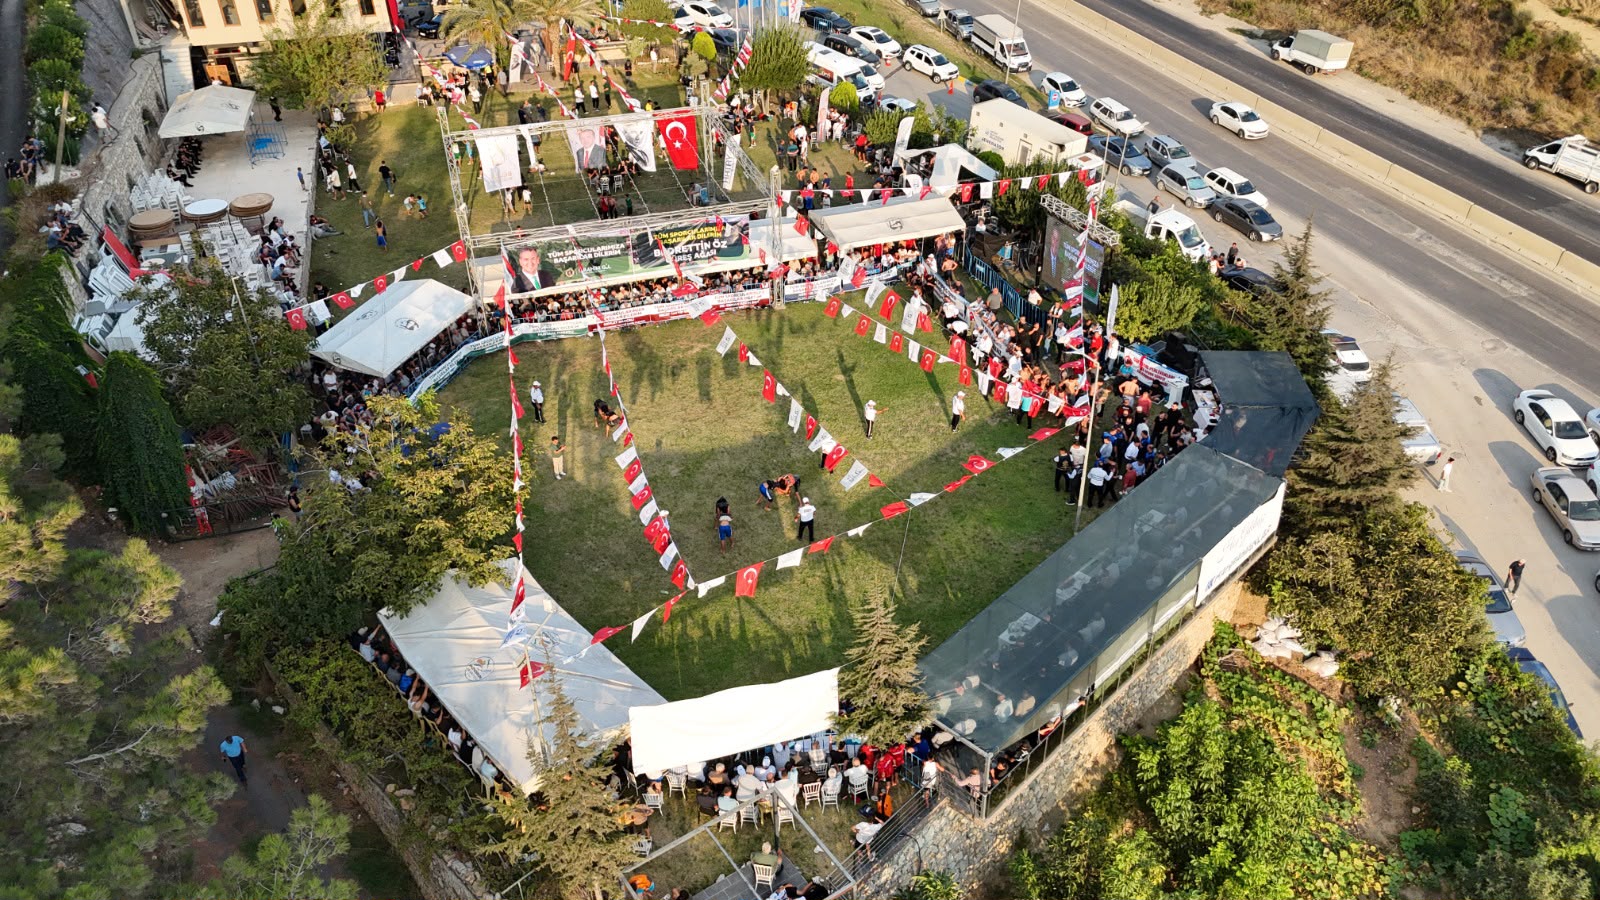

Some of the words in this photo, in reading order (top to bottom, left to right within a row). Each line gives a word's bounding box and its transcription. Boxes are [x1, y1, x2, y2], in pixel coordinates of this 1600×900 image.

[653, 231, 669, 240] TÜM
[669, 226, 726, 238] SPORCULARIMA
[547, 250, 564, 259] TÜM
[653, 240, 710, 257] BDRETTİN
[712, 238, 728, 249] ÖZ
[693, 248, 717, 259] AĞASI
[553, 253, 593, 264] BAŞARLAR
[593, 248, 621, 258] DİLERİM
